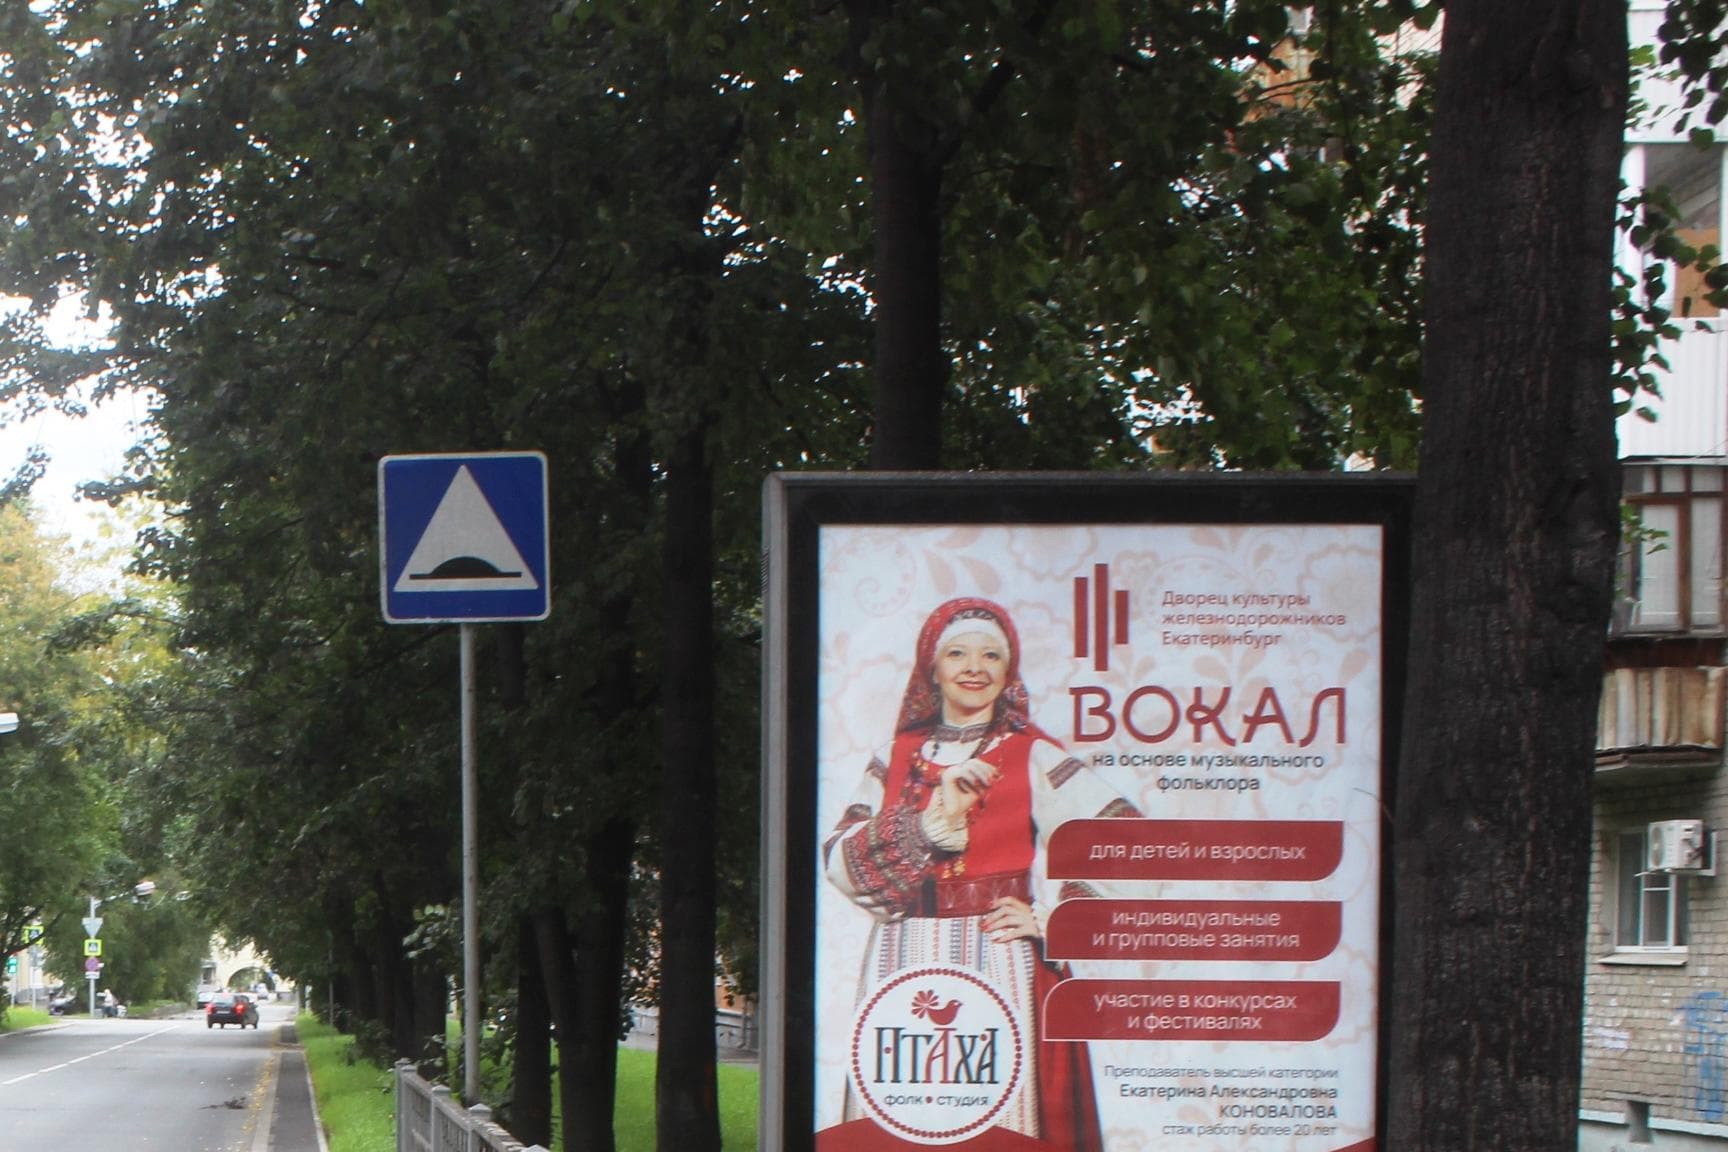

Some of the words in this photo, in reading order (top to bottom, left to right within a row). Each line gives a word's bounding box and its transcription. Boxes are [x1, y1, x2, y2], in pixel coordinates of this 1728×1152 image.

[1161, 591, 1227, 610] Дворец
[1232, 594, 1310, 610] культуры
[1161, 613, 1347, 629] железнодорожников
[1162, 631, 1283, 648] Екатеринбург
[1068, 684, 1347, 748] ВОКАЛ
[1092, 754, 1116, 767] на
[1118, 753, 1187, 767] основе
[1191, 754, 1325, 770] музыкального
[1156, 775, 1260, 791] фольклора
[1089, 844, 1126, 861] для
[1130, 842, 1189, 861] детей
[1194, 846, 1207, 859] и
[1211, 845, 1306, 863] взрослых
[1112, 911, 1281, 929] индивидуальные
[1092, 934, 1105, 947] и
[1109, 933, 1216, 950] групповые
[1220, 934, 1300, 948] занятия
[1094, 994, 1174, 1011] участие
[1179, 996, 1190, 1008] в
[1194, 996, 1297, 1012] конкурсах
[1127, 1016, 1140, 1029] и
[1143, 1013, 1262, 1033] фестивалях
[1104, 1065, 1211, 1080] Преподаватель
[1214, 1065, 1266, 1079] высшей
[1269, 1068, 1339, 1081] категории
[1119, 1084, 1206, 1100] Екатерина
[1210, 1084, 1338, 1101] Александровна
[1220, 1104, 1337, 1119] КОНОВАЛОВА
[1162, 1124, 1193, 1135] стаж
[1197, 1122, 1247, 1136] работы
[1250, 1122, 1290, 1136] более
[1294, 1124, 1310, 1136] 20
[1313, 1125, 1336, 1136] лет
